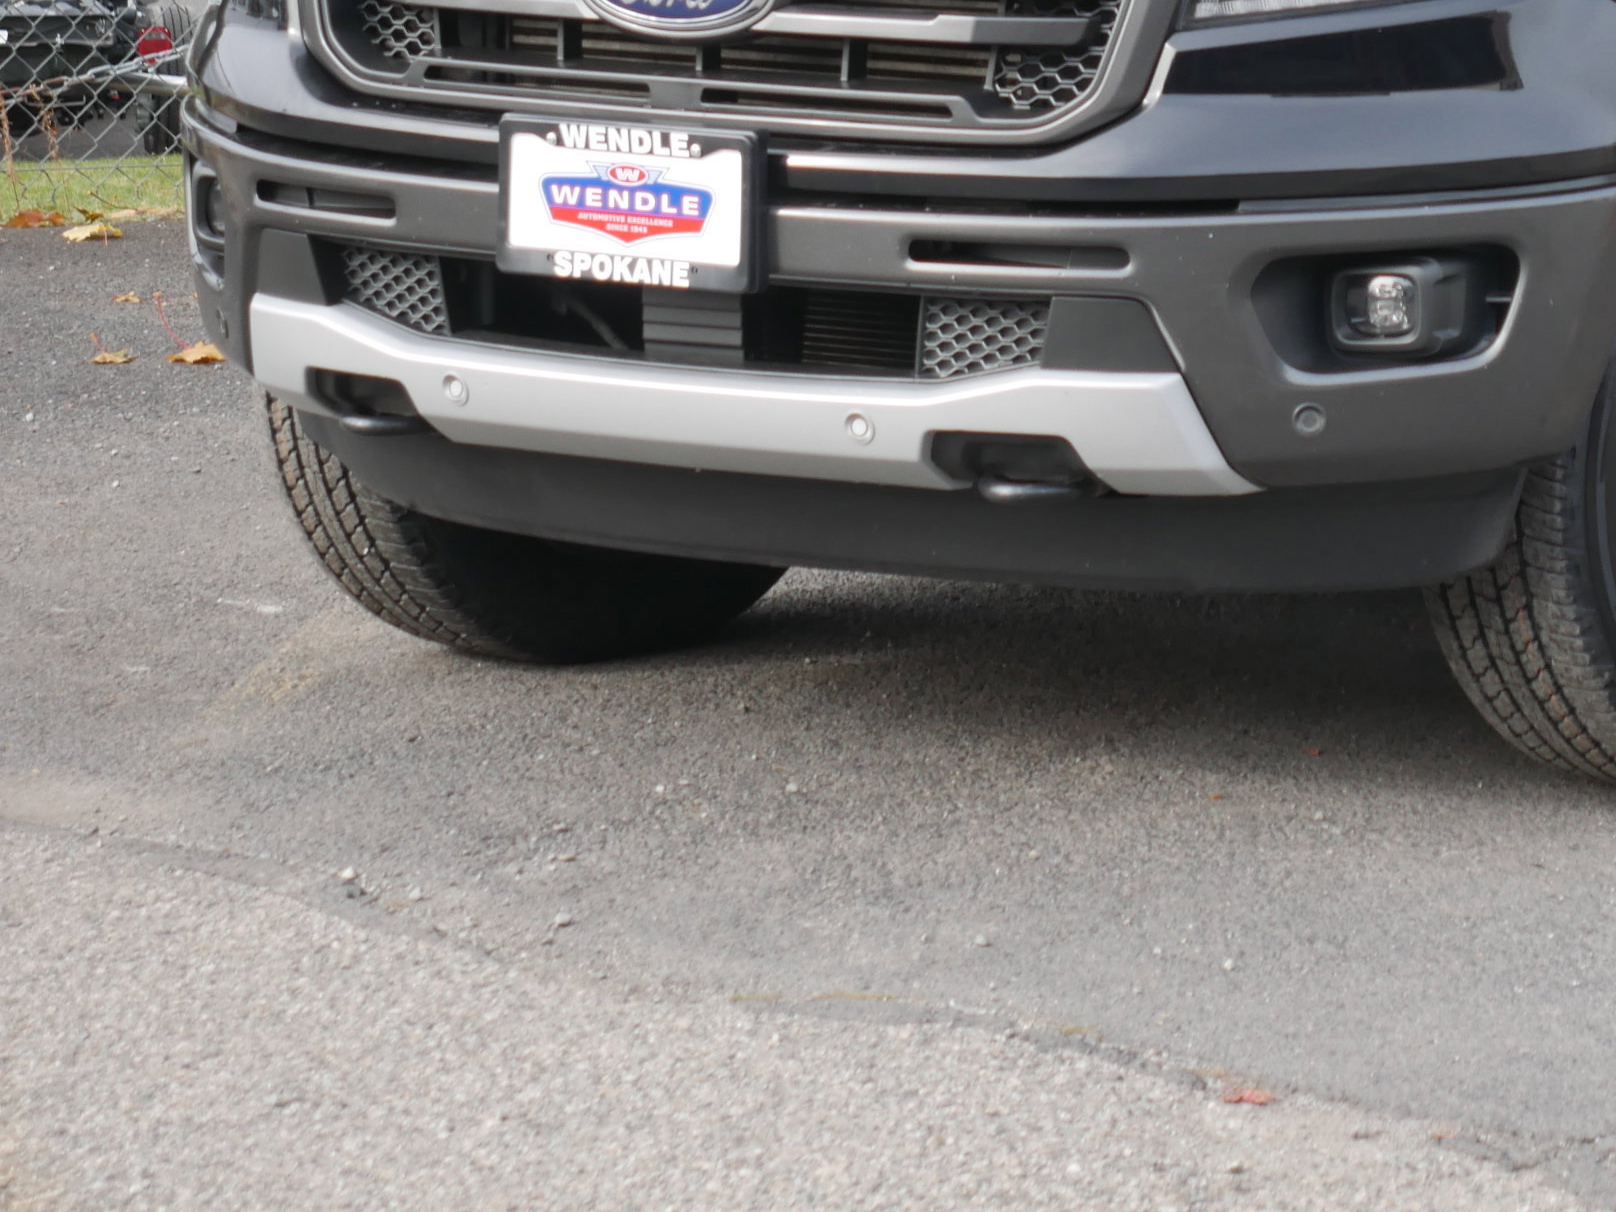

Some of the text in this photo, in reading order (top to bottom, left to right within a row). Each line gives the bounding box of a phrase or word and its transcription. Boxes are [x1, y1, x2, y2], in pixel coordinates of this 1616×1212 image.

[558, 123, 690, 157] WENDLE
[551, 185, 699, 215] WENDLE
[553, 250, 690, 288] SPOKANE
